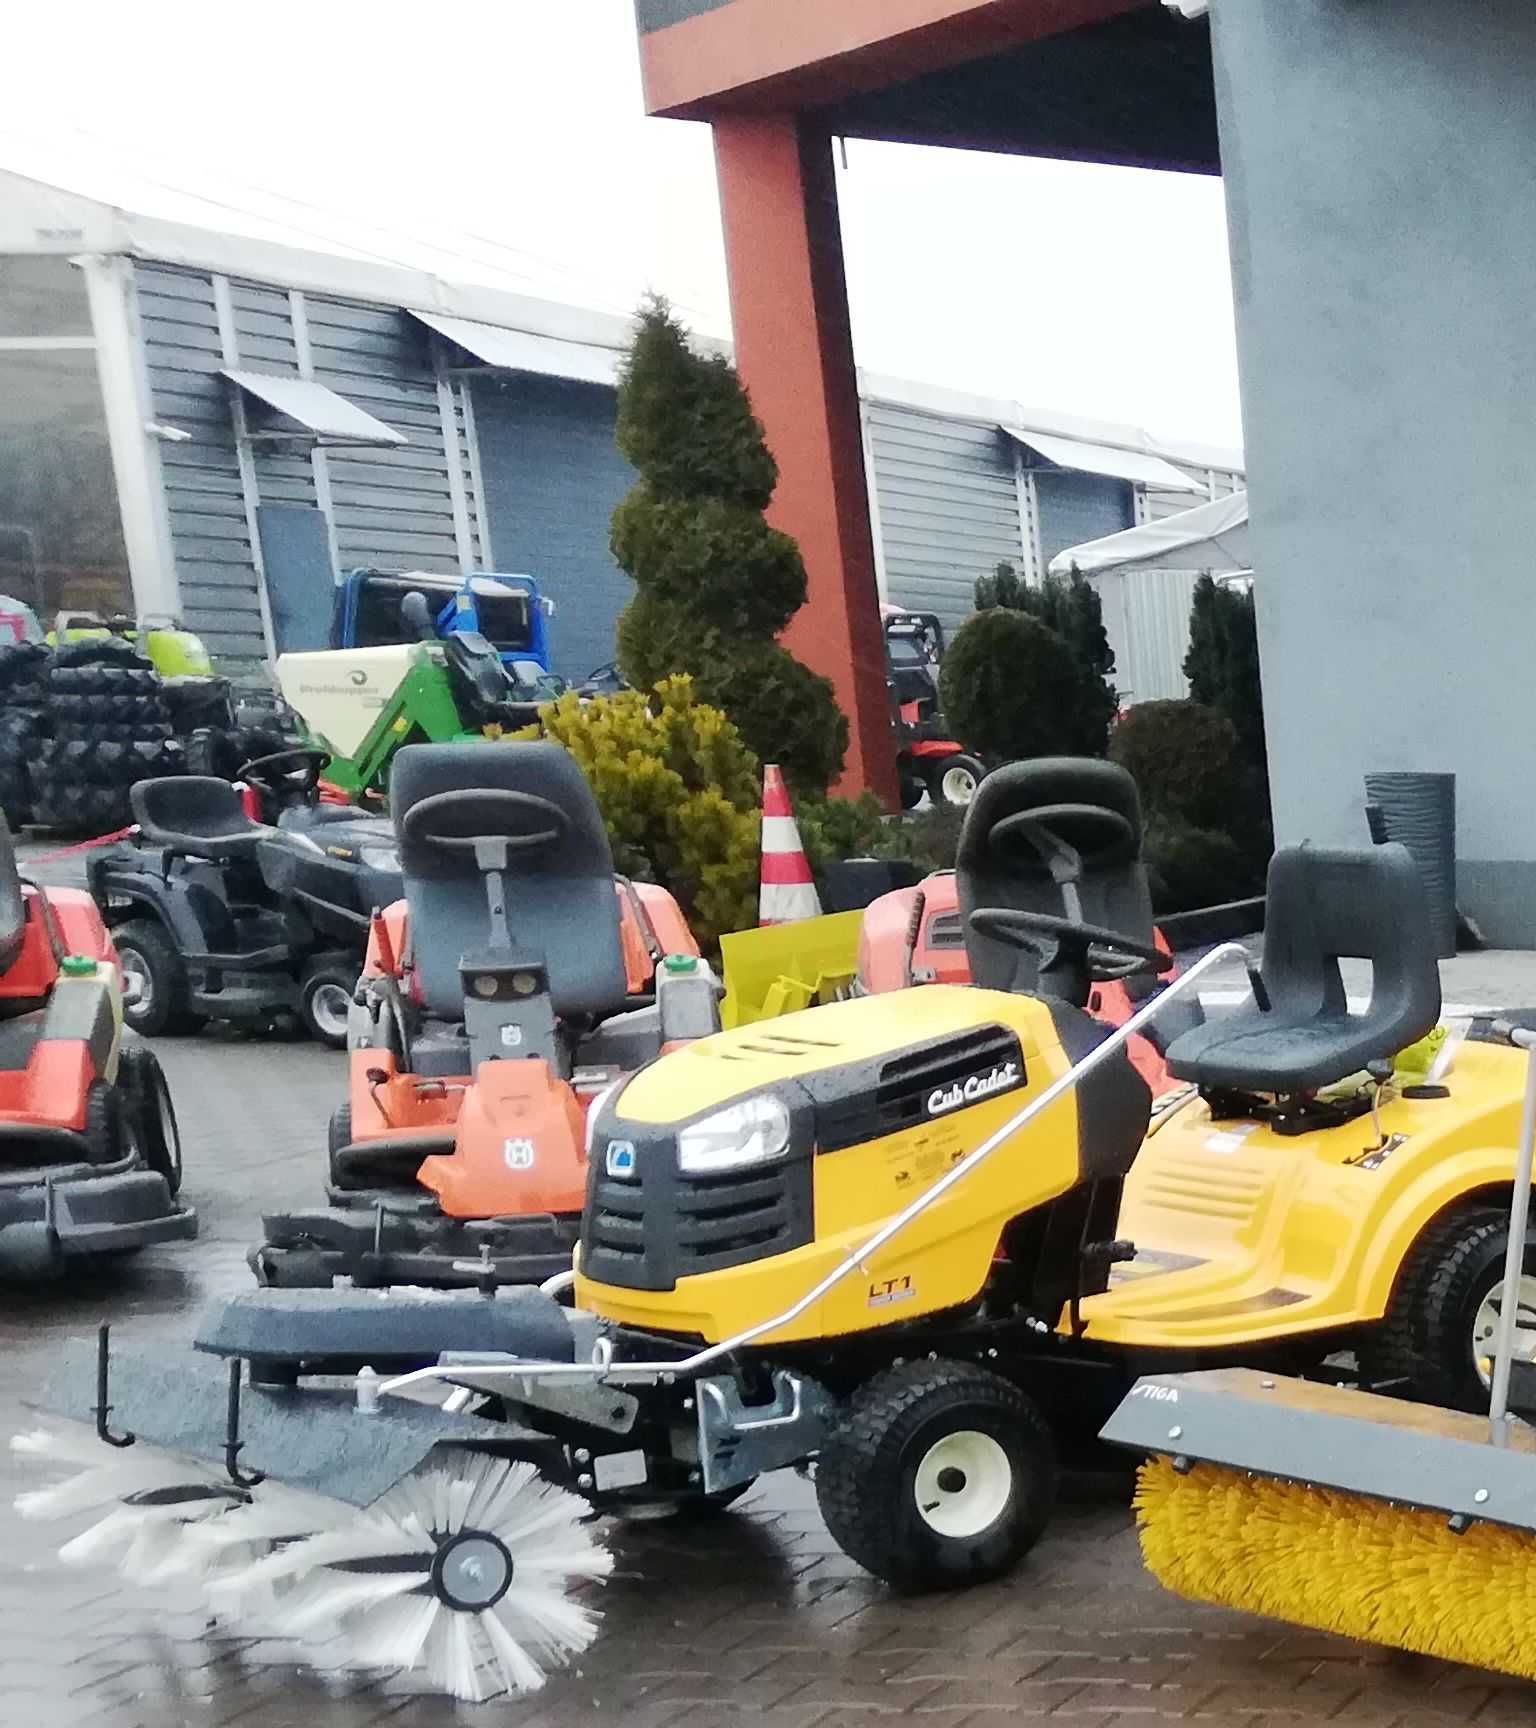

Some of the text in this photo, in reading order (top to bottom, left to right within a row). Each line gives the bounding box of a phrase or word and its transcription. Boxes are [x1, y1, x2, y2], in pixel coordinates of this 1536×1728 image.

[927, 1063, 1020, 1114] Cub Cadet
[868, 1275, 912, 1298] LT1
